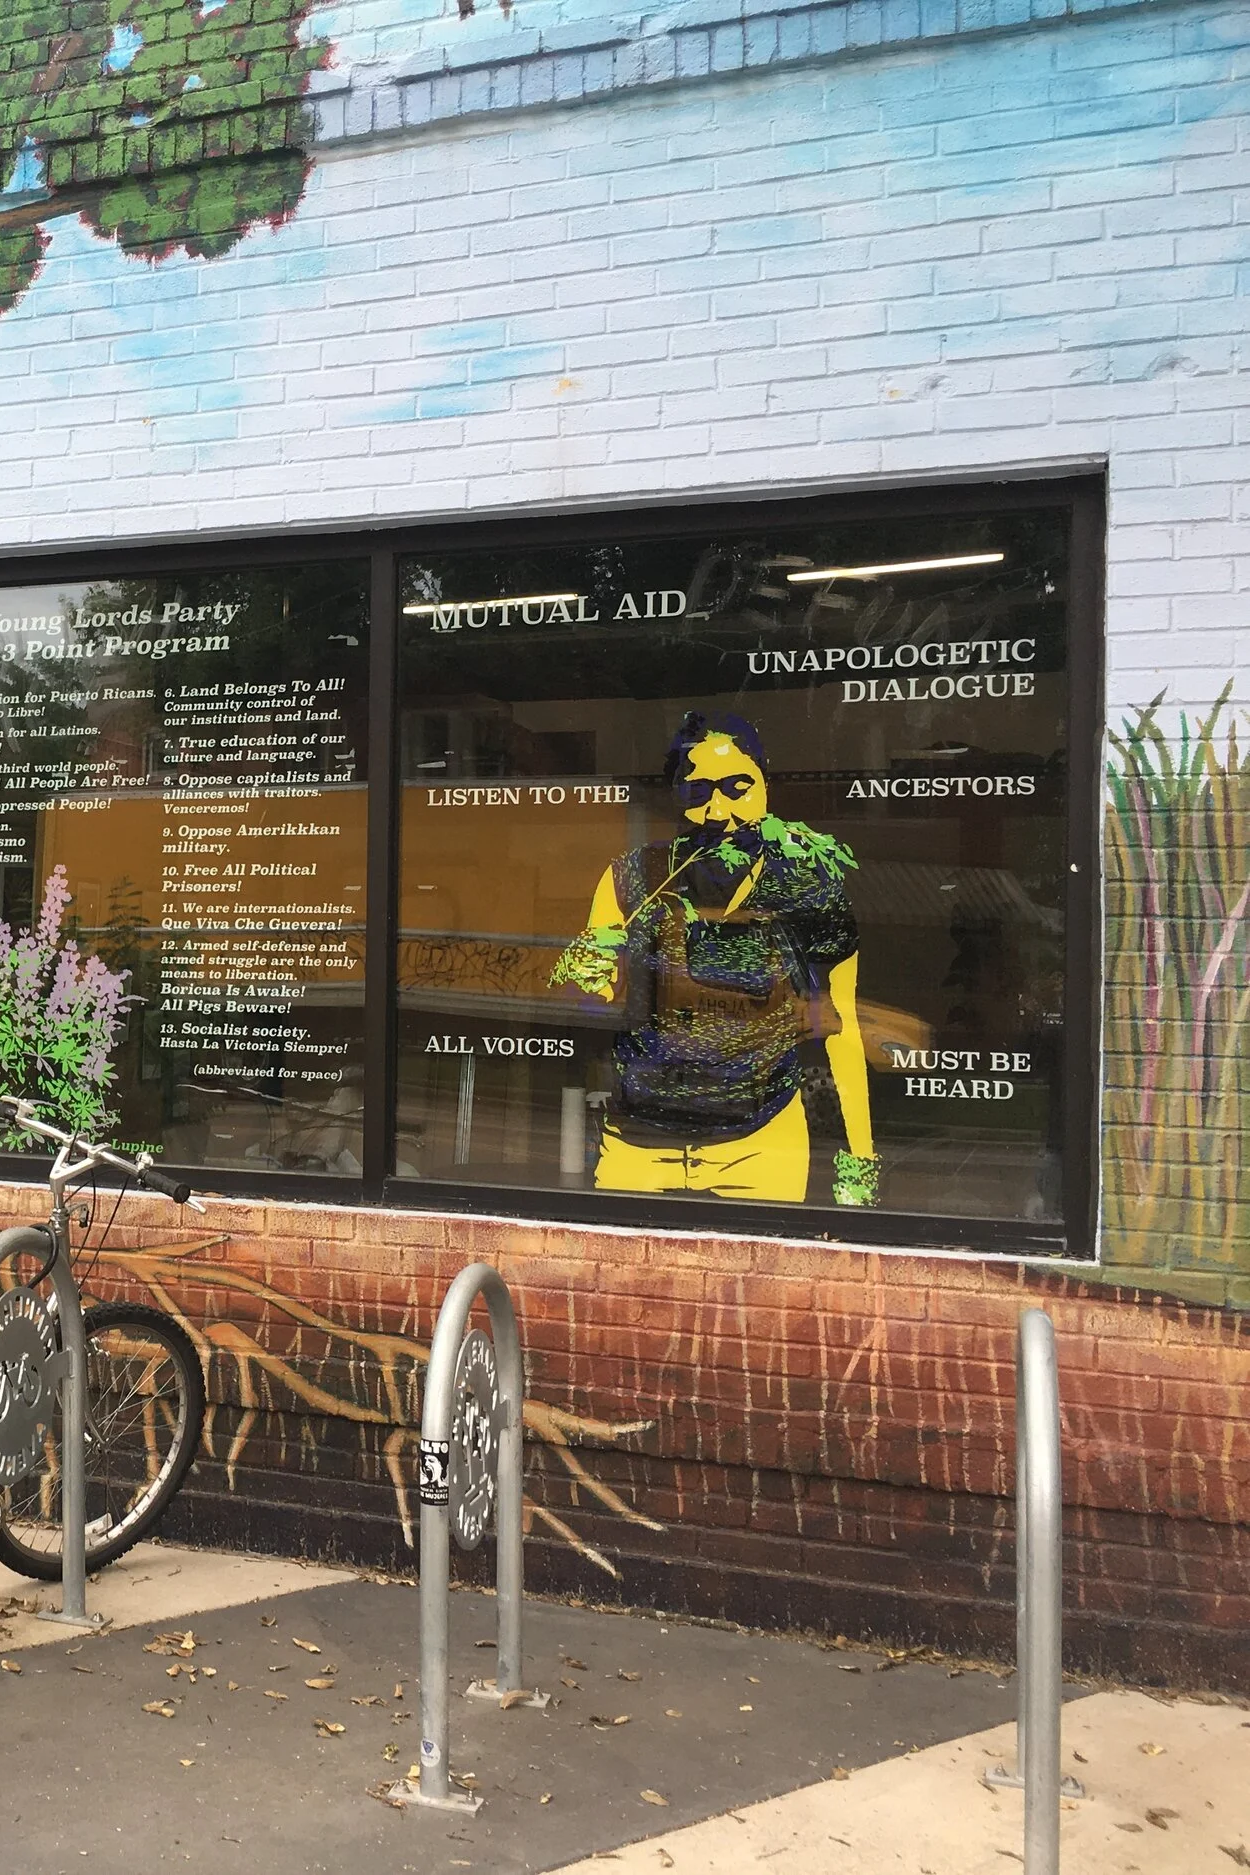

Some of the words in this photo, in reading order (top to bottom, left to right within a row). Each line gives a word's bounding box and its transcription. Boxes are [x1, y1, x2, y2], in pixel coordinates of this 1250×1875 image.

[72, 604, 153, 629] Lords
[159, 600, 241, 626] Party
[429, 595, 600, 631] MUTUAL
[612, 589, 688, 620] AID
[23, 638, 97, 662] Point
[102, 634, 231, 660] Program
[746, 638, 1035, 674] UNAPOLOGETIC
[163, 687, 175, 698] 6.
[178, 682, 219, 697] Land
[222, 681, 286, 696] Belongs
[290, 679, 311, 692] To
[314, 677, 345, 691] All!
[840, 672, 1035, 703] DIALOGUE
[163, 698, 243, 712] Community
[245, 695, 296, 709] control
[299, 694, 316, 706] of
[163, 717, 188, 726] our
[190, 712, 271, 725] institutions
[273, 709, 302, 722] and
[304, 708, 341, 721] land.
[163, 738, 173, 749] 7.
[178, 736, 216, 748] True
[219, 732, 297, 747] education
[301, 732, 318, 744] of
[319, 734, 346, 744] our
[162, 751, 213, 763] culture
[215, 749, 243, 761] and
[245, 749, 316, 763] language.
[3, 776, 26, 789] All
[28, 774, 77, 791] People
[79, 775, 108, 787] Are
[110, 773, 150, 786] Free!
[162, 775, 174, 786] 8.
[178, 773, 232, 788] Oppose
[236, 770, 320, 787] capitalists
[323, 769, 351, 782] and
[845, 775, 1035, 798] ANCESTORS
[162, 788, 224, 800] alliances
[227, 786, 260, 798] with
[263, 785, 322, 798] traitors.
[426, 786, 521, 806] LISTEN
[528, 785, 565, 804] TO
[572, 784, 630, 803] THE
[58, 797, 112, 812] People!
[163, 801, 250, 814] Venceremos!
[162, 826, 173, 837] 9.
[177, 824, 232, 840] Oppose
[235, 822, 340, 838] Amerikkkan
[161, 840, 230, 855] military.
[161, 865, 179, 876] 10.
[182, 863, 218, 876] Free
[221, 863, 246, 876] All
[248, 862, 317, 876] Political
[160, 879, 242, 892] Prisoners!
[160, 902, 177, 913] 11.
[182, 902, 203, 913] We
[205, 904, 230, 913] are
[232, 902, 356, 914] internationalists.
[160, 916, 191, 930] Que
[195, 916, 230, 930] Viva
[234, 916, 264, 930] Che
[268, 917, 342, 930] Guevera!
[159, 982, 221, 996] Boricua
[224, 983, 240, 996] Is
[243, 983, 306, 997] Awake!
[159, 998, 183, 1011] All
[186, 998, 221, 1015] Pigs
[224, 999, 291, 1014] Beware!
[159, 1023, 177, 1034] 13.
[180, 1021, 248, 1036] Socialist
[251, 1024, 311, 1041] society.
[159, 1036, 198, 1048] Hasta
[201, 1037, 219, 1049] La
[224, 1038, 280, 1052] Victoria
[282, 1040, 348, 1056] Siempre!
[423, 1034, 474, 1053] ALL
[480, 1036, 574, 1057] VOICES
[891, 1048, 980, 1070] MUST
[988, 1051, 1031, 1072] BE
[904, 1076, 1014, 1100] HEARD
[111, 1138, 164, 1154] Lupine
